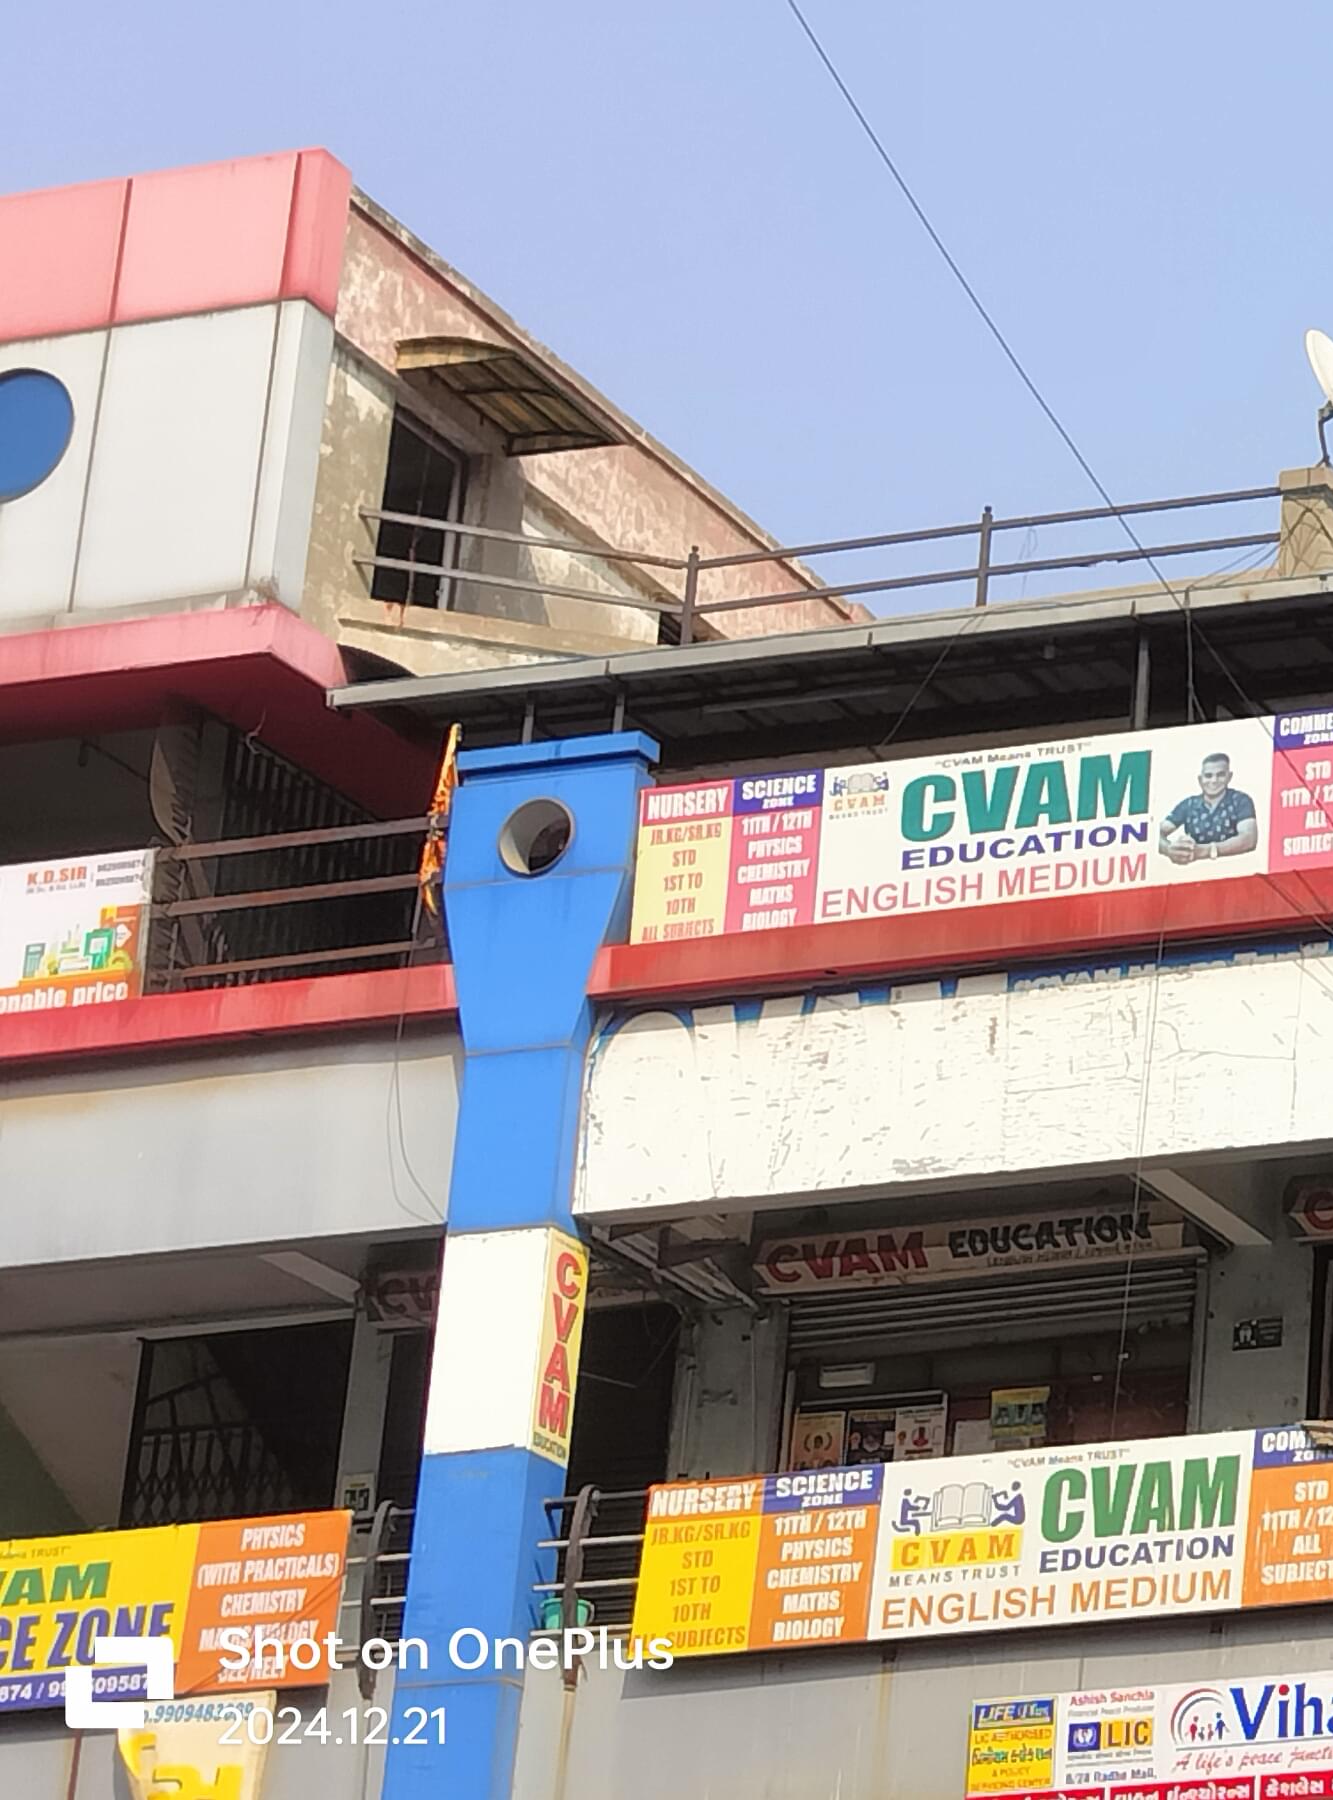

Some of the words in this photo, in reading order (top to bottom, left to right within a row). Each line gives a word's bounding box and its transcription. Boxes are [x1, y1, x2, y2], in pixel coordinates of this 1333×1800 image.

[742, 775, 817, 800] SCIENCE
[900, 750, 1153, 842] CVAM
[648, 787, 728, 820] NURSERY
[748, 836, 803, 860] PHYSICS
[901, 822, 1149, 871] EDUCATION
[737, 859, 810, 884] CHEMISTRY
[821, 872, 983, 918] ENGLISH
[998, 853, 1147, 898] MEDIUM
[749, 885, 794, 906] MATHS
[742, 908, 797, 931] BIOLOGY
[766, 1231, 928, 1283] CVAM
[947, 1211, 1151, 1259] EDUCATION
[539, 1251, 582, 1439] CVAM
[776, 1469, 873, 1497] SCIENCE
[1294, 1480, 1328, 1502] STD
[651, 1483, 756, 1517] NURSERY
[802, 1492, 843, 1507] ZONE
[1041, 1454, 1241, 1543] CVAM
[241, 1523, 306, 1552] PHYSICS
[781, 1536, 853, 1562] PHYSICS
[901, 1533, 1015, 1567] CVAM
[1292, 1533, 1321, 1556] ALL
[682, 1551, 713, 1570] STD
[1039, 1535, 1234, 1574] EDUCATION
[197, 1563, 240, 1589] (WITH
[243, 1553, 340, 1585] PRACTICALS)
[767, 1562, 861, 1590] CHEMISTRY
[889, 1571, 954, 1588] MEANS
[960, 1565, 1022, 1582] TRUST
[221, 1588, 307, 1618] CHEMISTRY
[672, 1603, 711, 1622] 10TH
[783, 1590, 841, 1615] MATHS
[882, 1584, 1056, 1630] ENGLISH
[1071, 1568, 1231, 1613] MEDIUM
[773, 1617, 844, 1642] BIOLOGY
[1108, 1720, 1149, 1747] LIC
